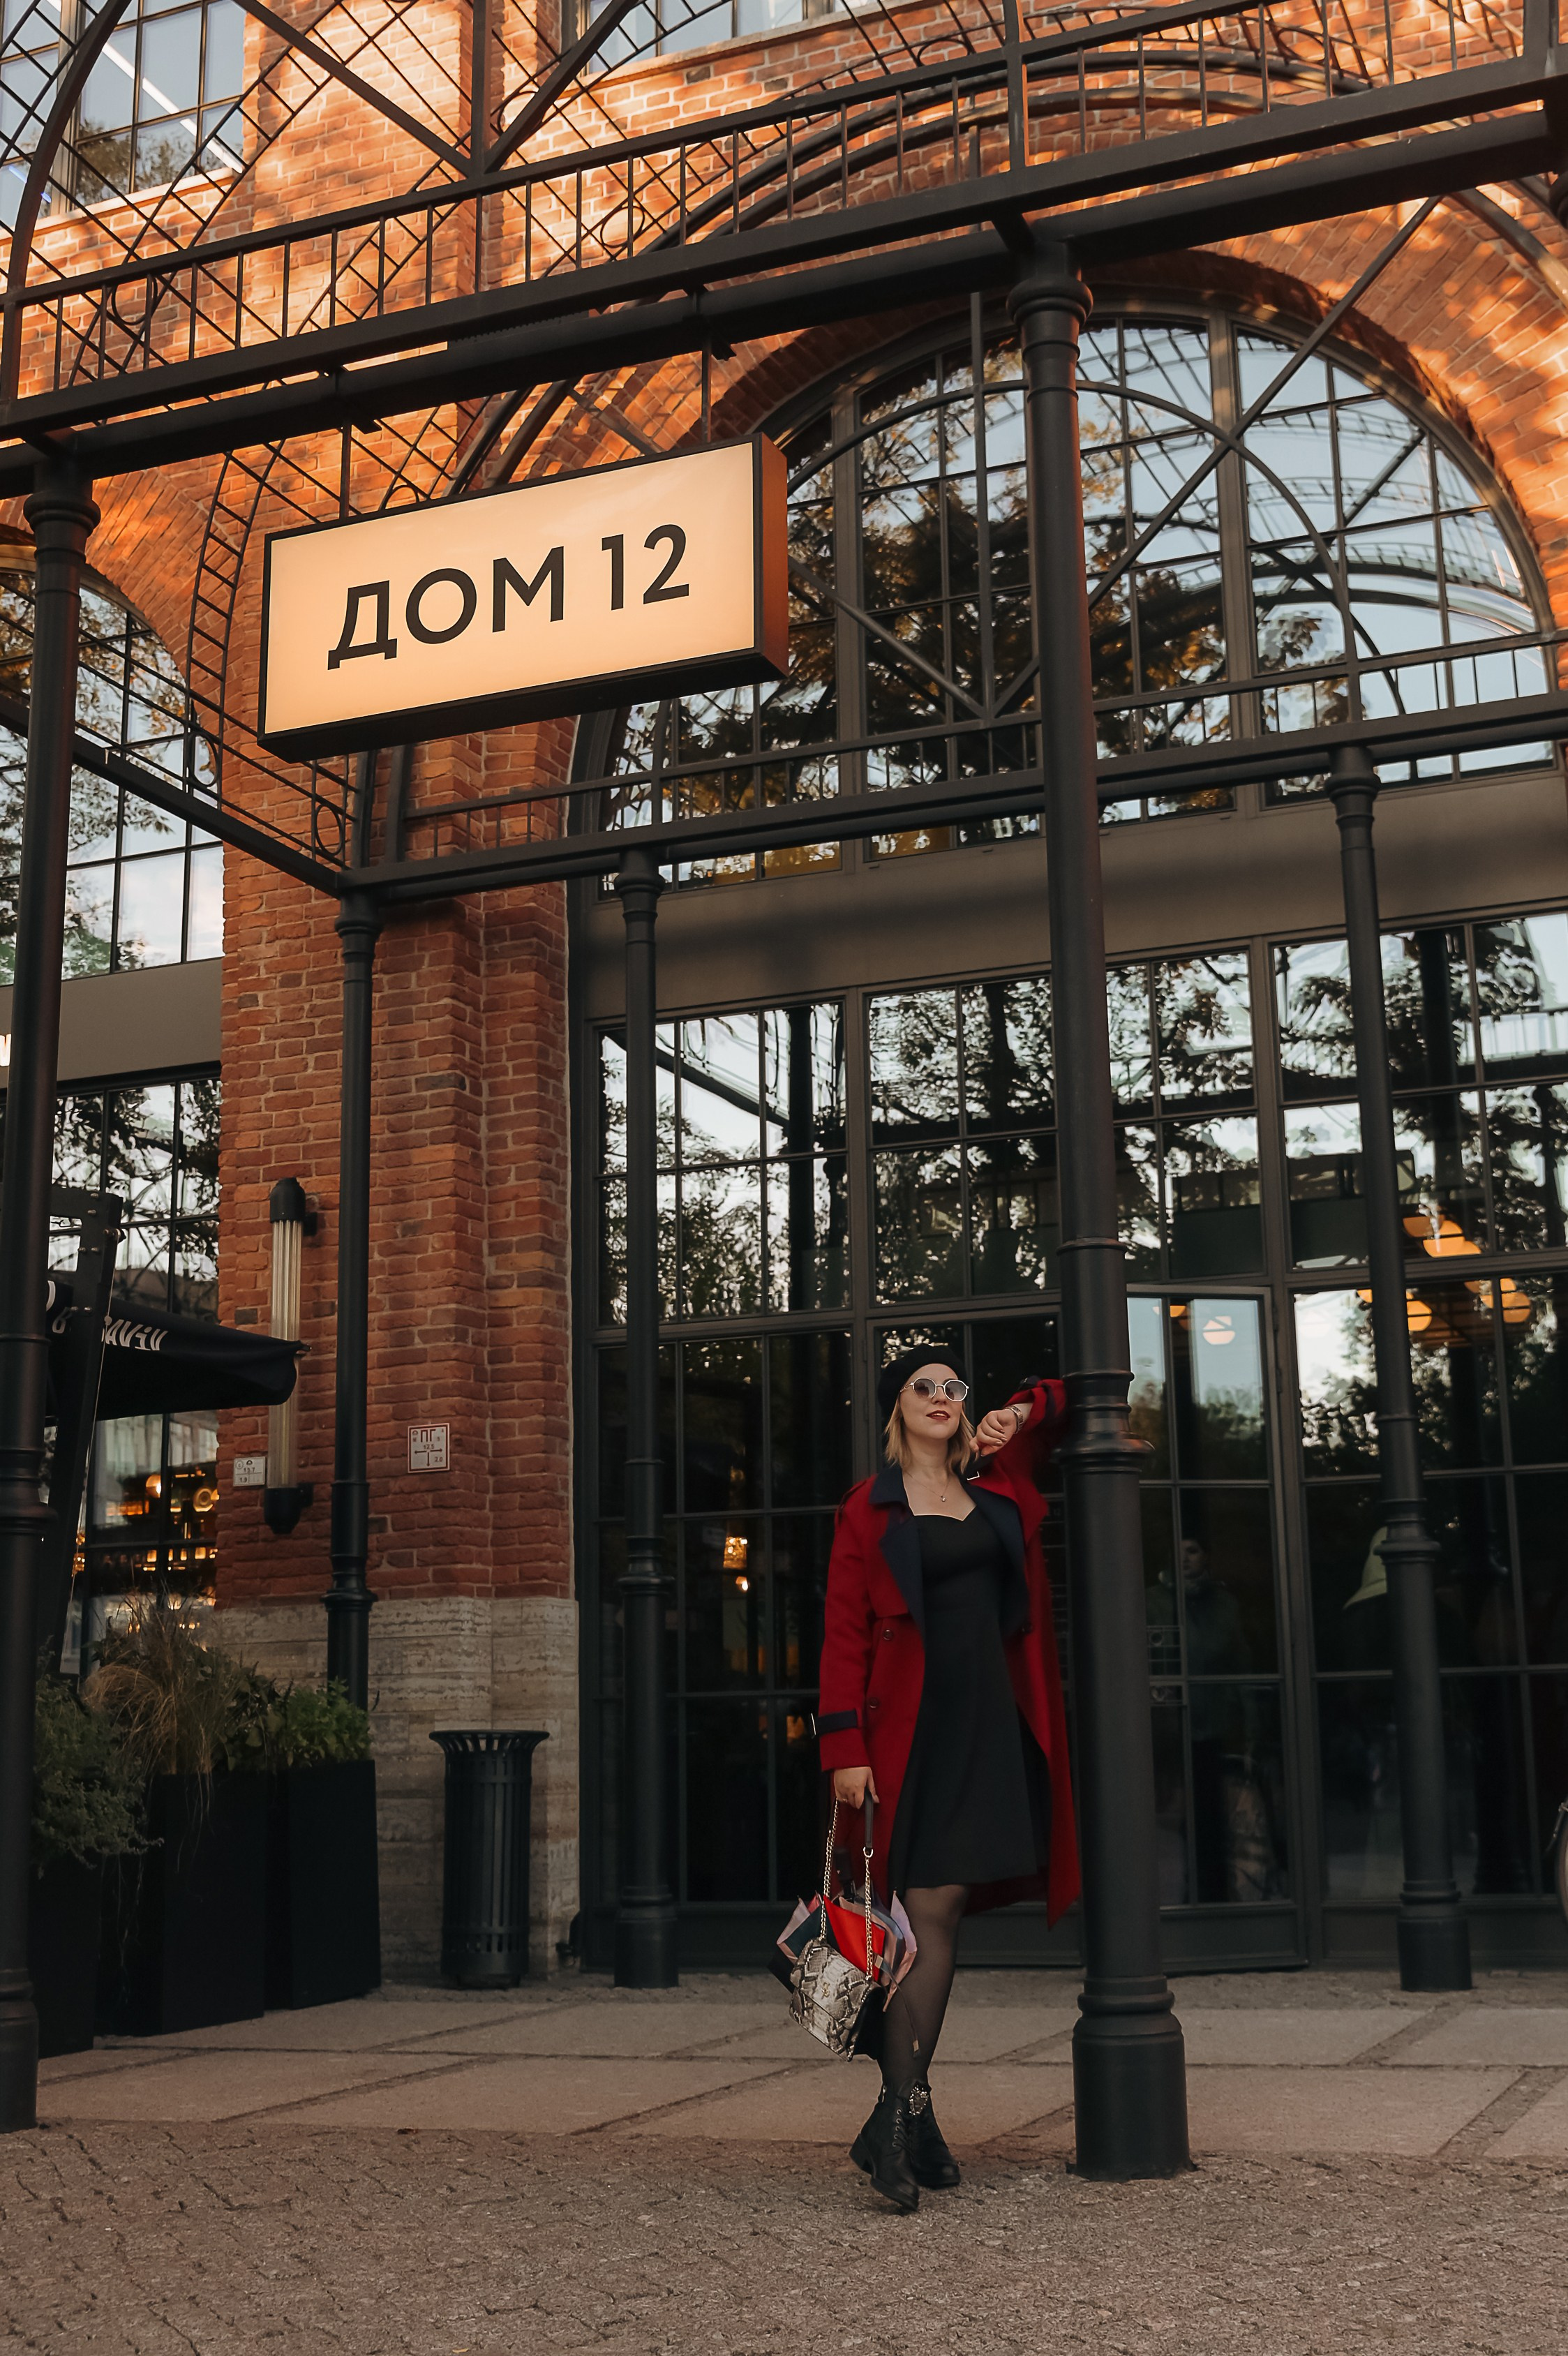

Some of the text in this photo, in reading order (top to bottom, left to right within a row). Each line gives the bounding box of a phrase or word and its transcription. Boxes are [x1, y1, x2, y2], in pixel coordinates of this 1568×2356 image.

[327, 524, 689, 670] ДОМ 12
[421, 1429, 435, 1442] ПГ
